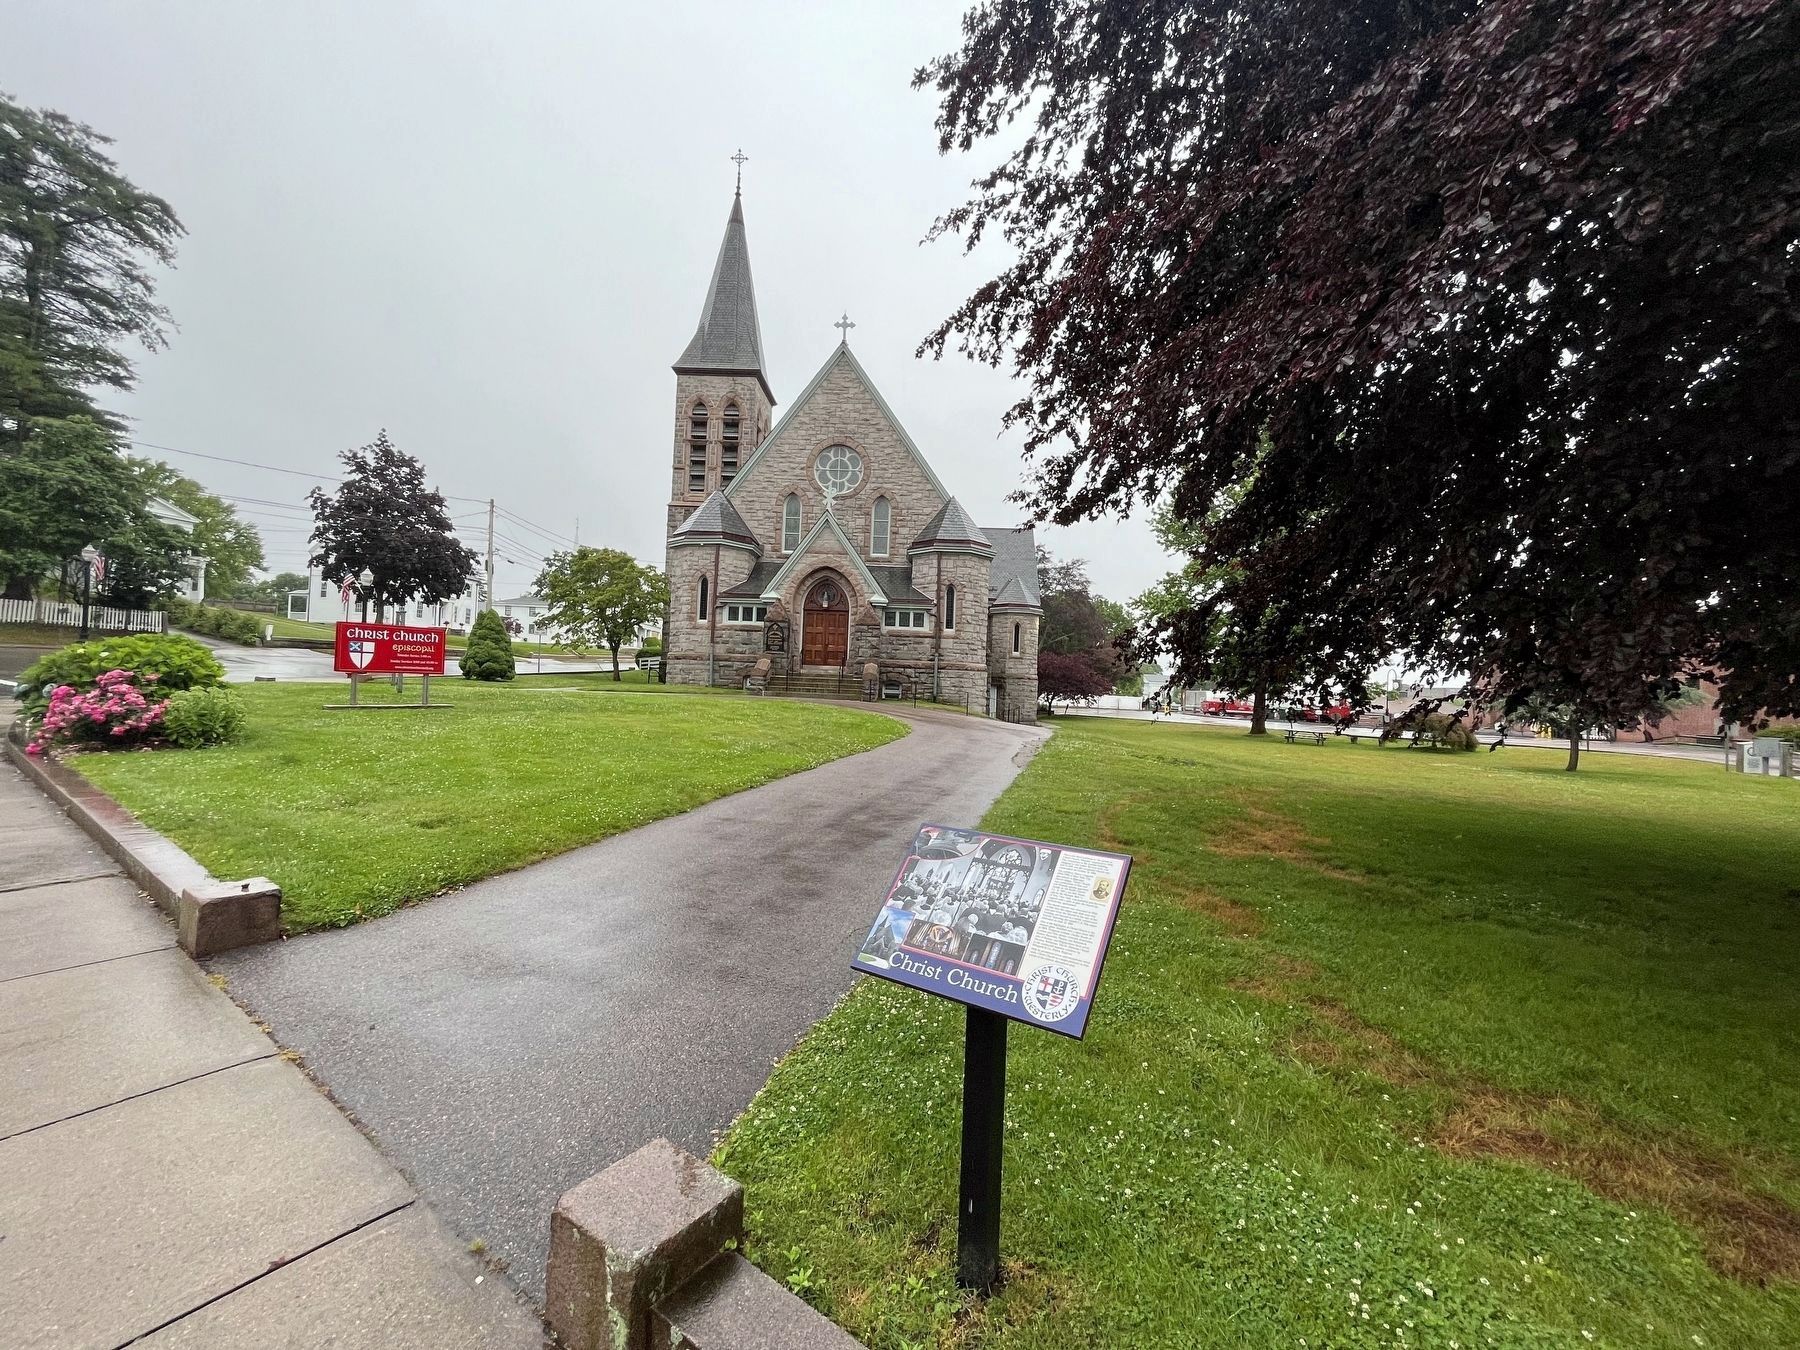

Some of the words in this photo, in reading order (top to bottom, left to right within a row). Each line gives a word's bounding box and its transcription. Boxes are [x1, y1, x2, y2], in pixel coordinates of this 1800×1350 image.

[889, 951, 942, 980] Christ
[947, 968, 1018, 1003] Church
[1024, 995, 1069, 1020] WESTERLY
